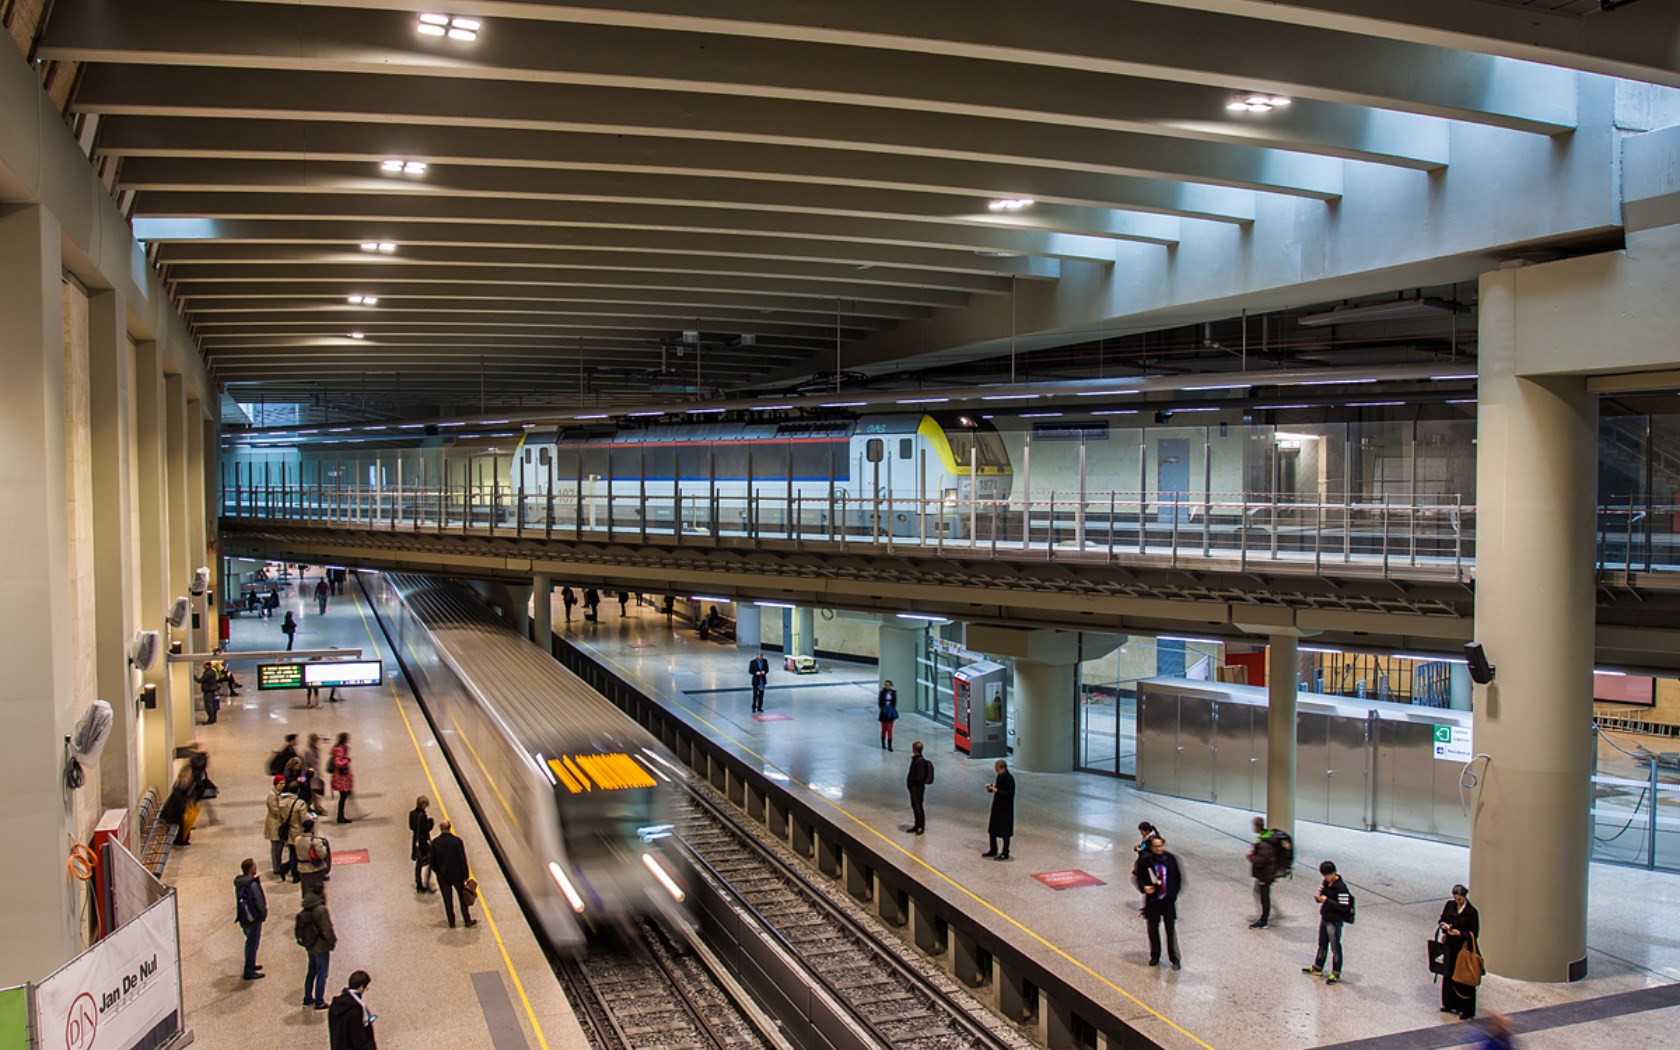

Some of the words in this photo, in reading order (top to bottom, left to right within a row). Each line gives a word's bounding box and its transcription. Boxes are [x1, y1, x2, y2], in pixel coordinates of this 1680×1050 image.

[99, 987, 120, 1013] Jan
[122, 974, 138, 995] De
[139, 954, 158, 982] Nul
